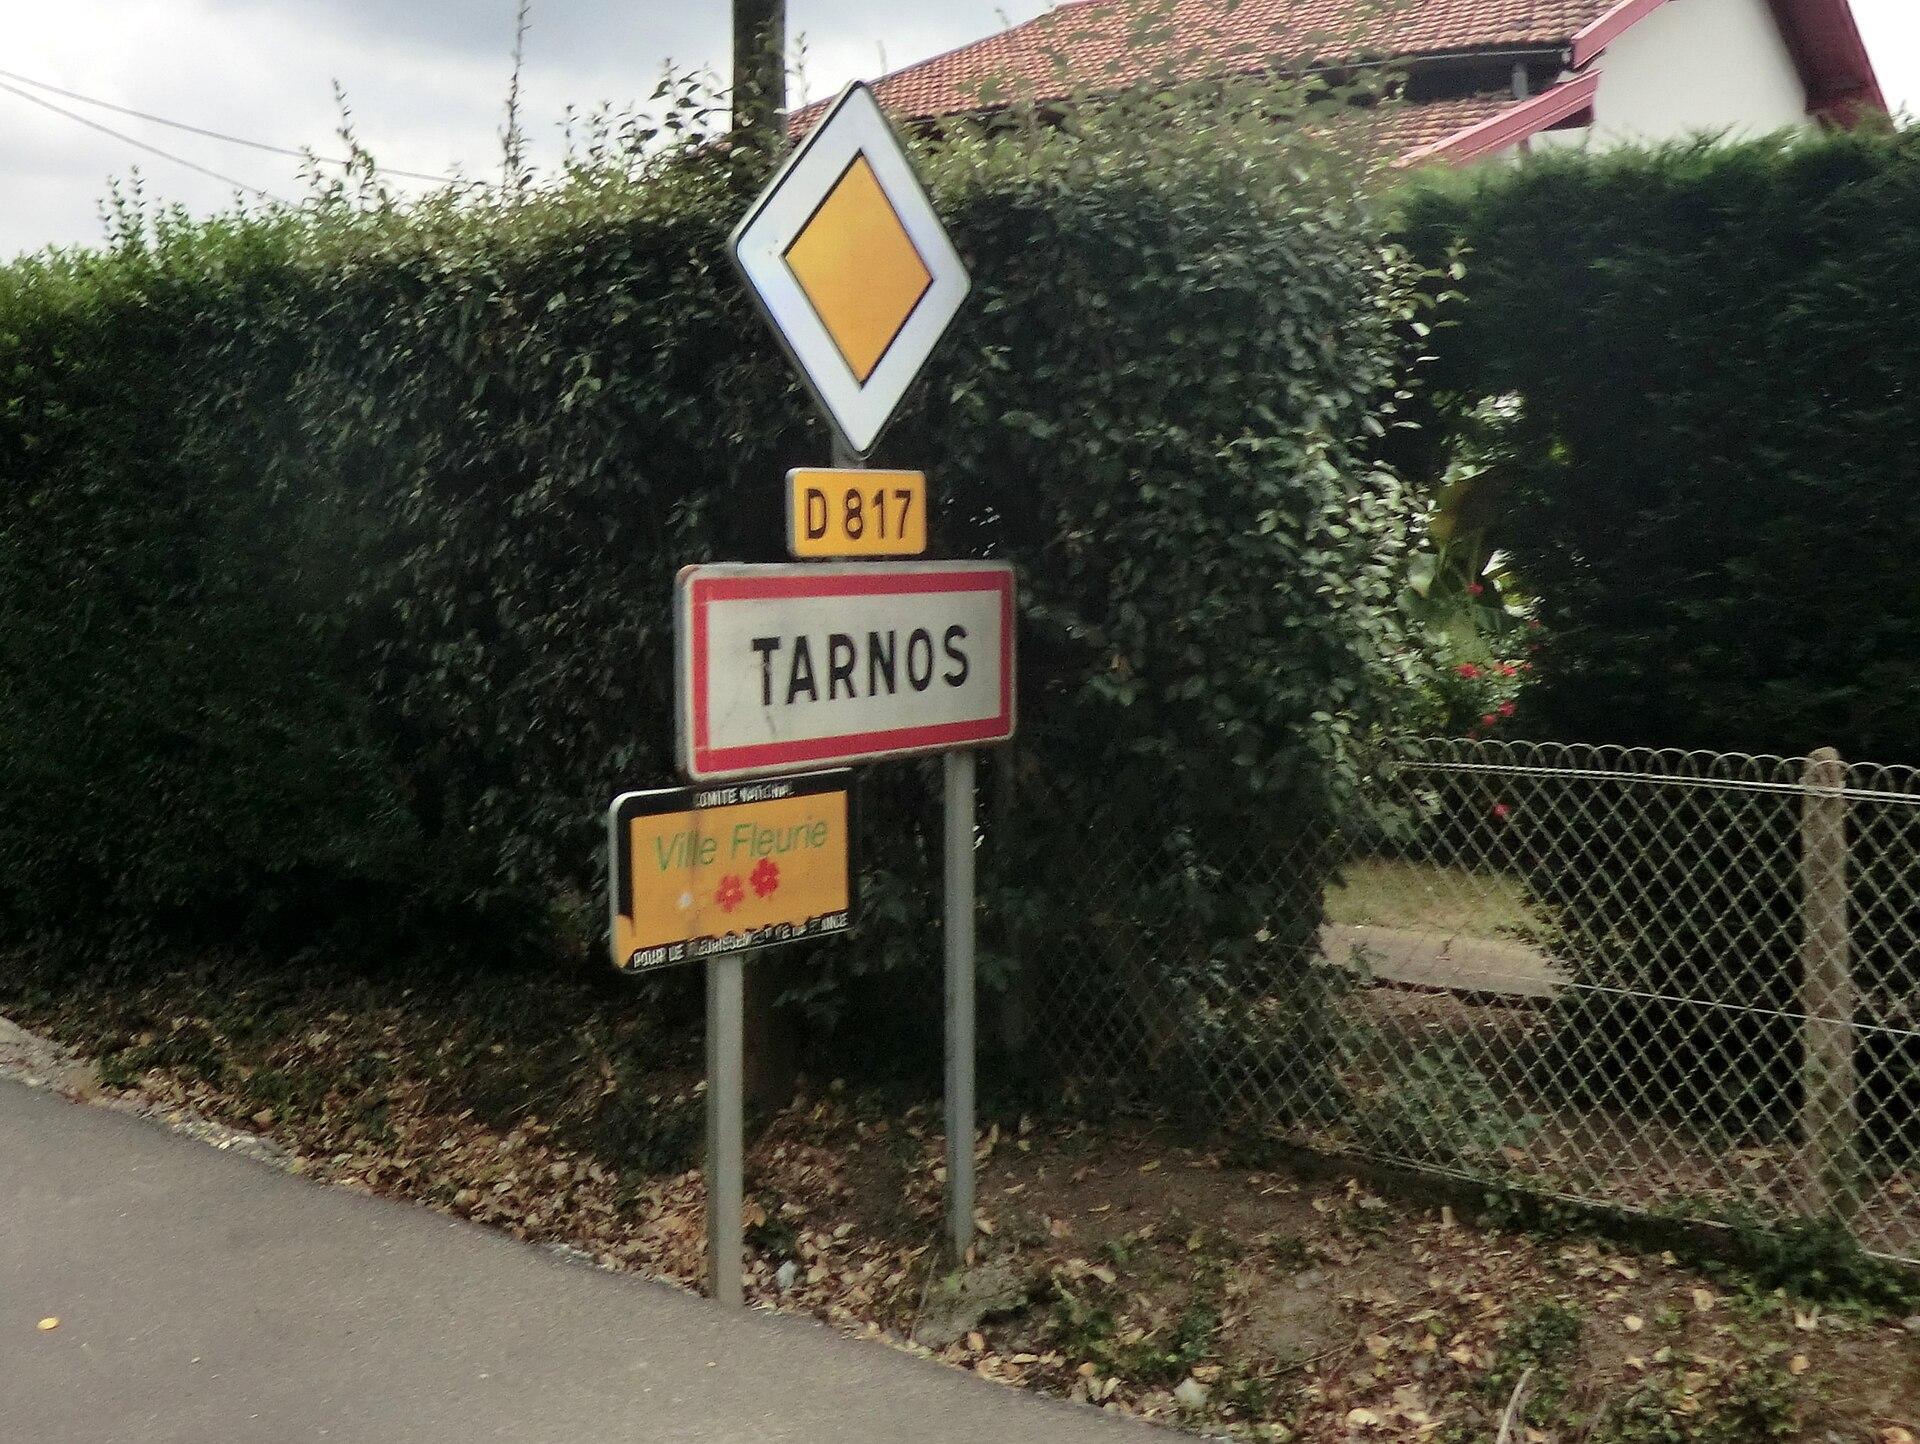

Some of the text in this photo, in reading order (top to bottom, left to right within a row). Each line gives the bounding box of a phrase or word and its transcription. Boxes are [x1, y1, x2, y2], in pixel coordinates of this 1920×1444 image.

[806, 488, 912, 541] D 817
[751, 623, 969, 708] TARNOS
[655, 818, 828, 872] Ville Fleurie
[633, 948, 668, 968] POUR
